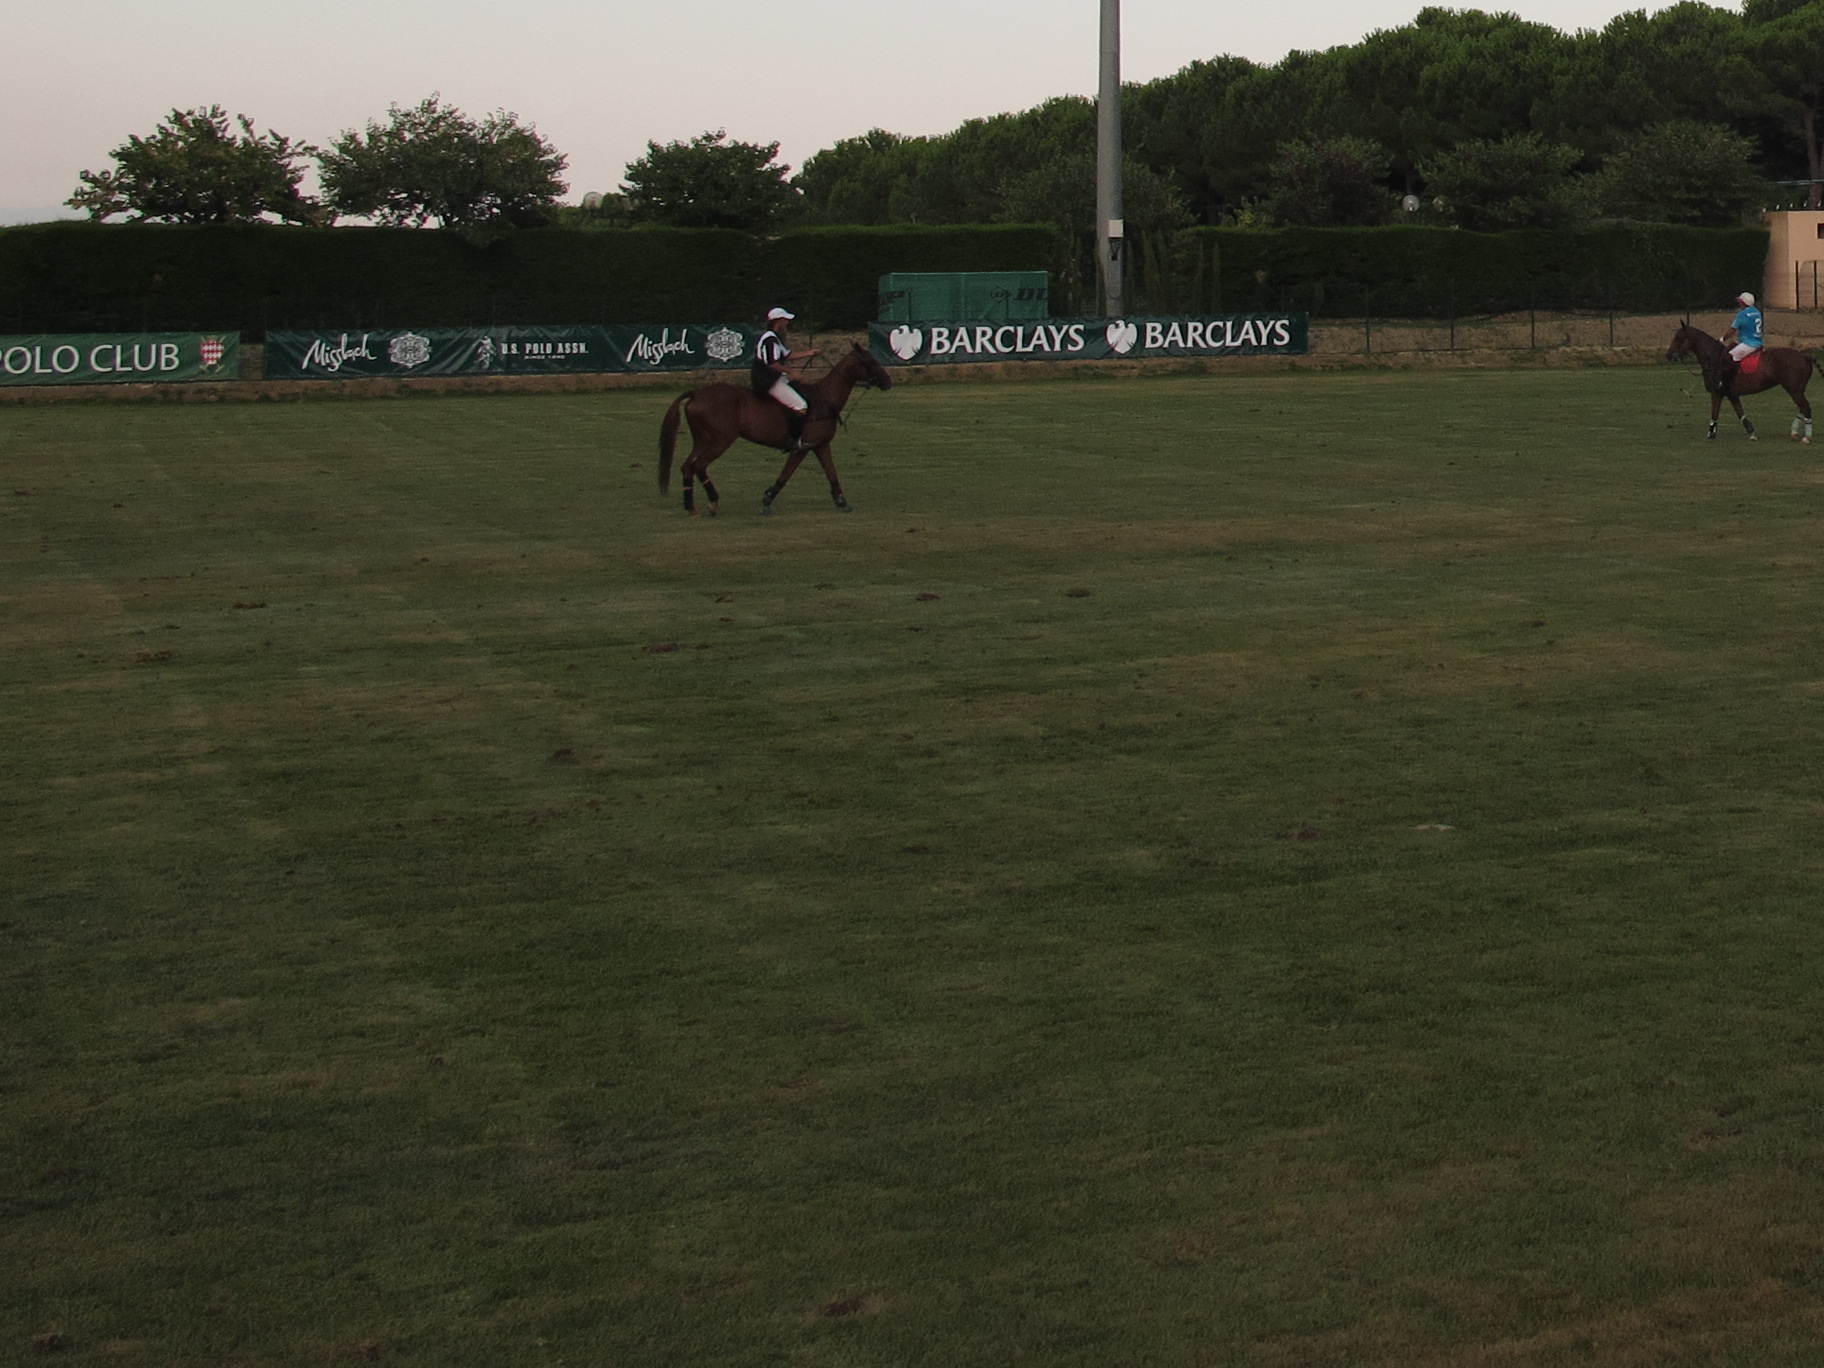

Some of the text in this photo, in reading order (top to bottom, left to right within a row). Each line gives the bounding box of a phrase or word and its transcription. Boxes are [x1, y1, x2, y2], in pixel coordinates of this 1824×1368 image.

[500, 342, 589, 355] U.S. POLO ASSN.
[930, 324, 1085, 355] BARCLAYS
[1145, 319, 1291, 349] BARCLAYS
[0, 343, 181, 374] OLO CLUB
